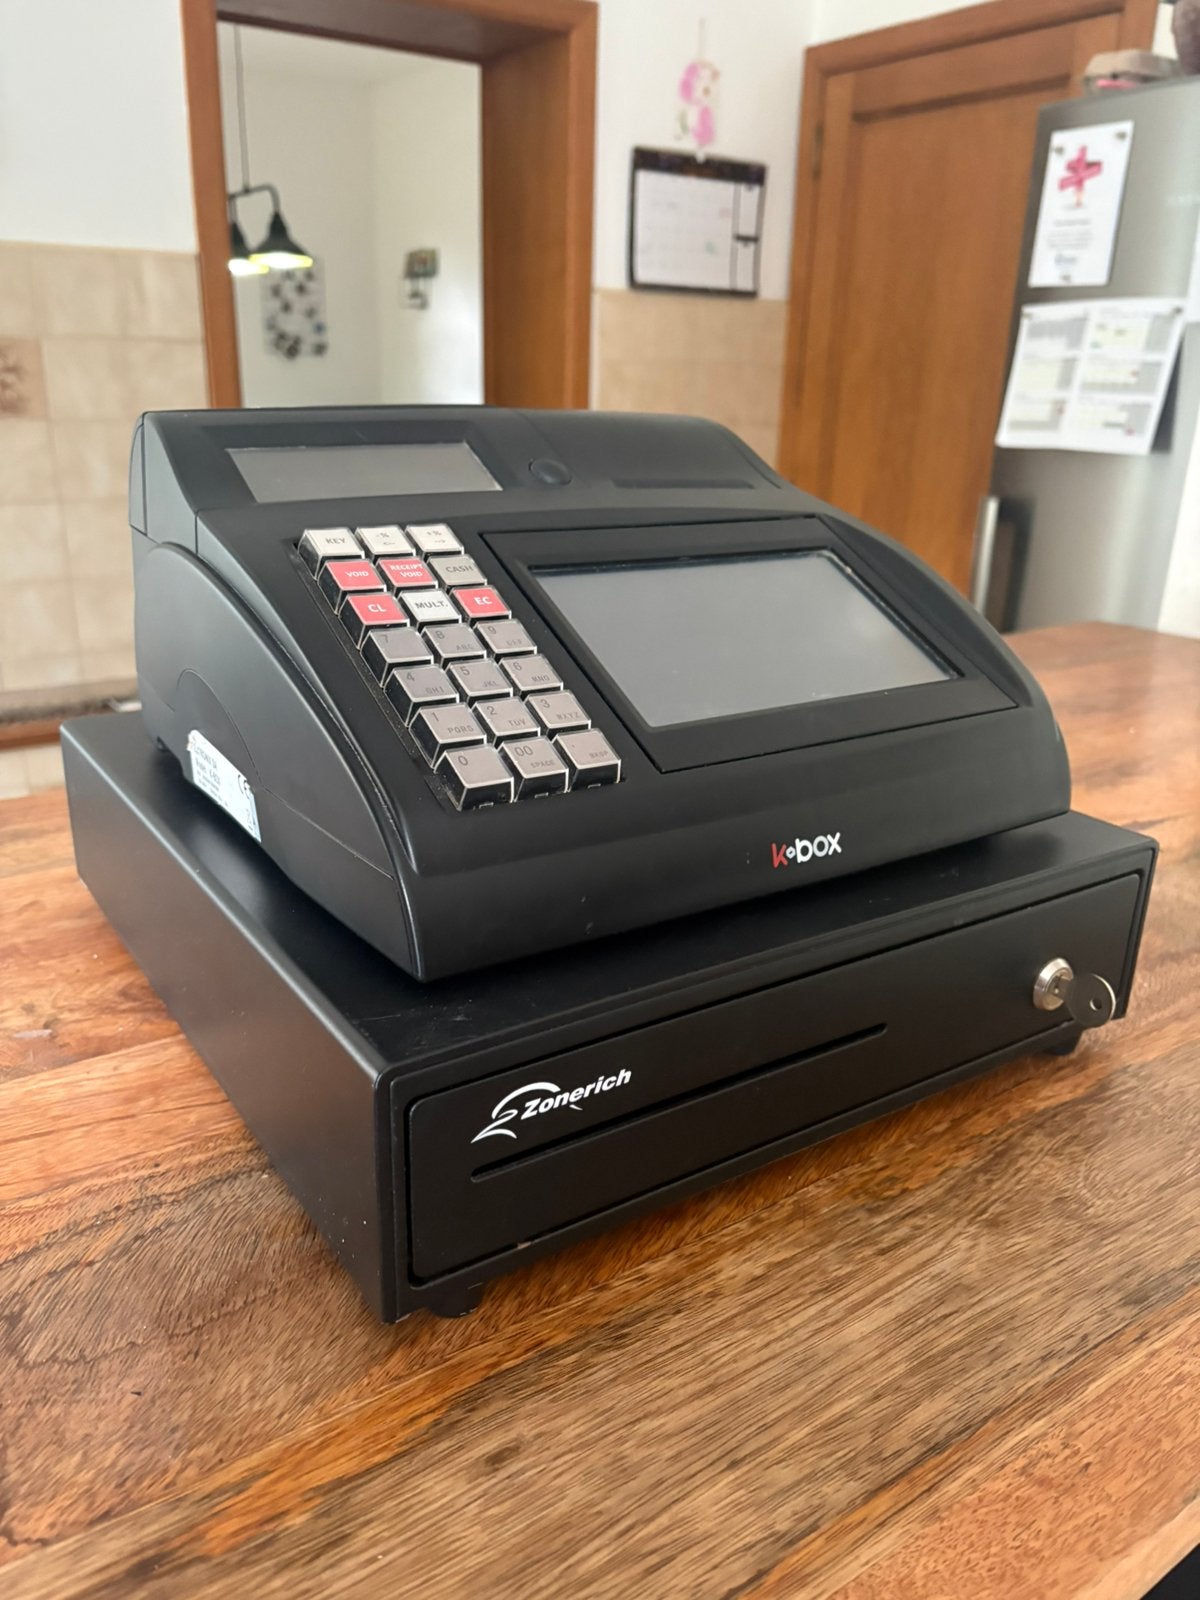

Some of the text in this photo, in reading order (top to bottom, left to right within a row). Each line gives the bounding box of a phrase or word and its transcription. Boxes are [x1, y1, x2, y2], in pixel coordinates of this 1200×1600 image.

[445, 565, 473, 573] CASH
[414, 601, 449, 609] MULT.
[473, 596, 493, 605] EC
[368, 603, 387, 613] CL
[435, 630, 446, 640] 8
[486, 625, 497, 635] 9
[381, 634, 389, 643] 7
[459, 666, 471, 676] 5
[512, 662, 523, 672] 6
[406, 672, 416, 682] 4
[540, 699, 551, 709] 3
[486, 706, 498, 715] 2
[431, 712, 440, 722] 1
[508, 718, 527, 727] TUV
[514, 746, 534, 757] 00
[458, 755, 469, 767] 0
[530, 759, 556, 768] SPACE
[521, 1068, 632, 1120] Zonerich
